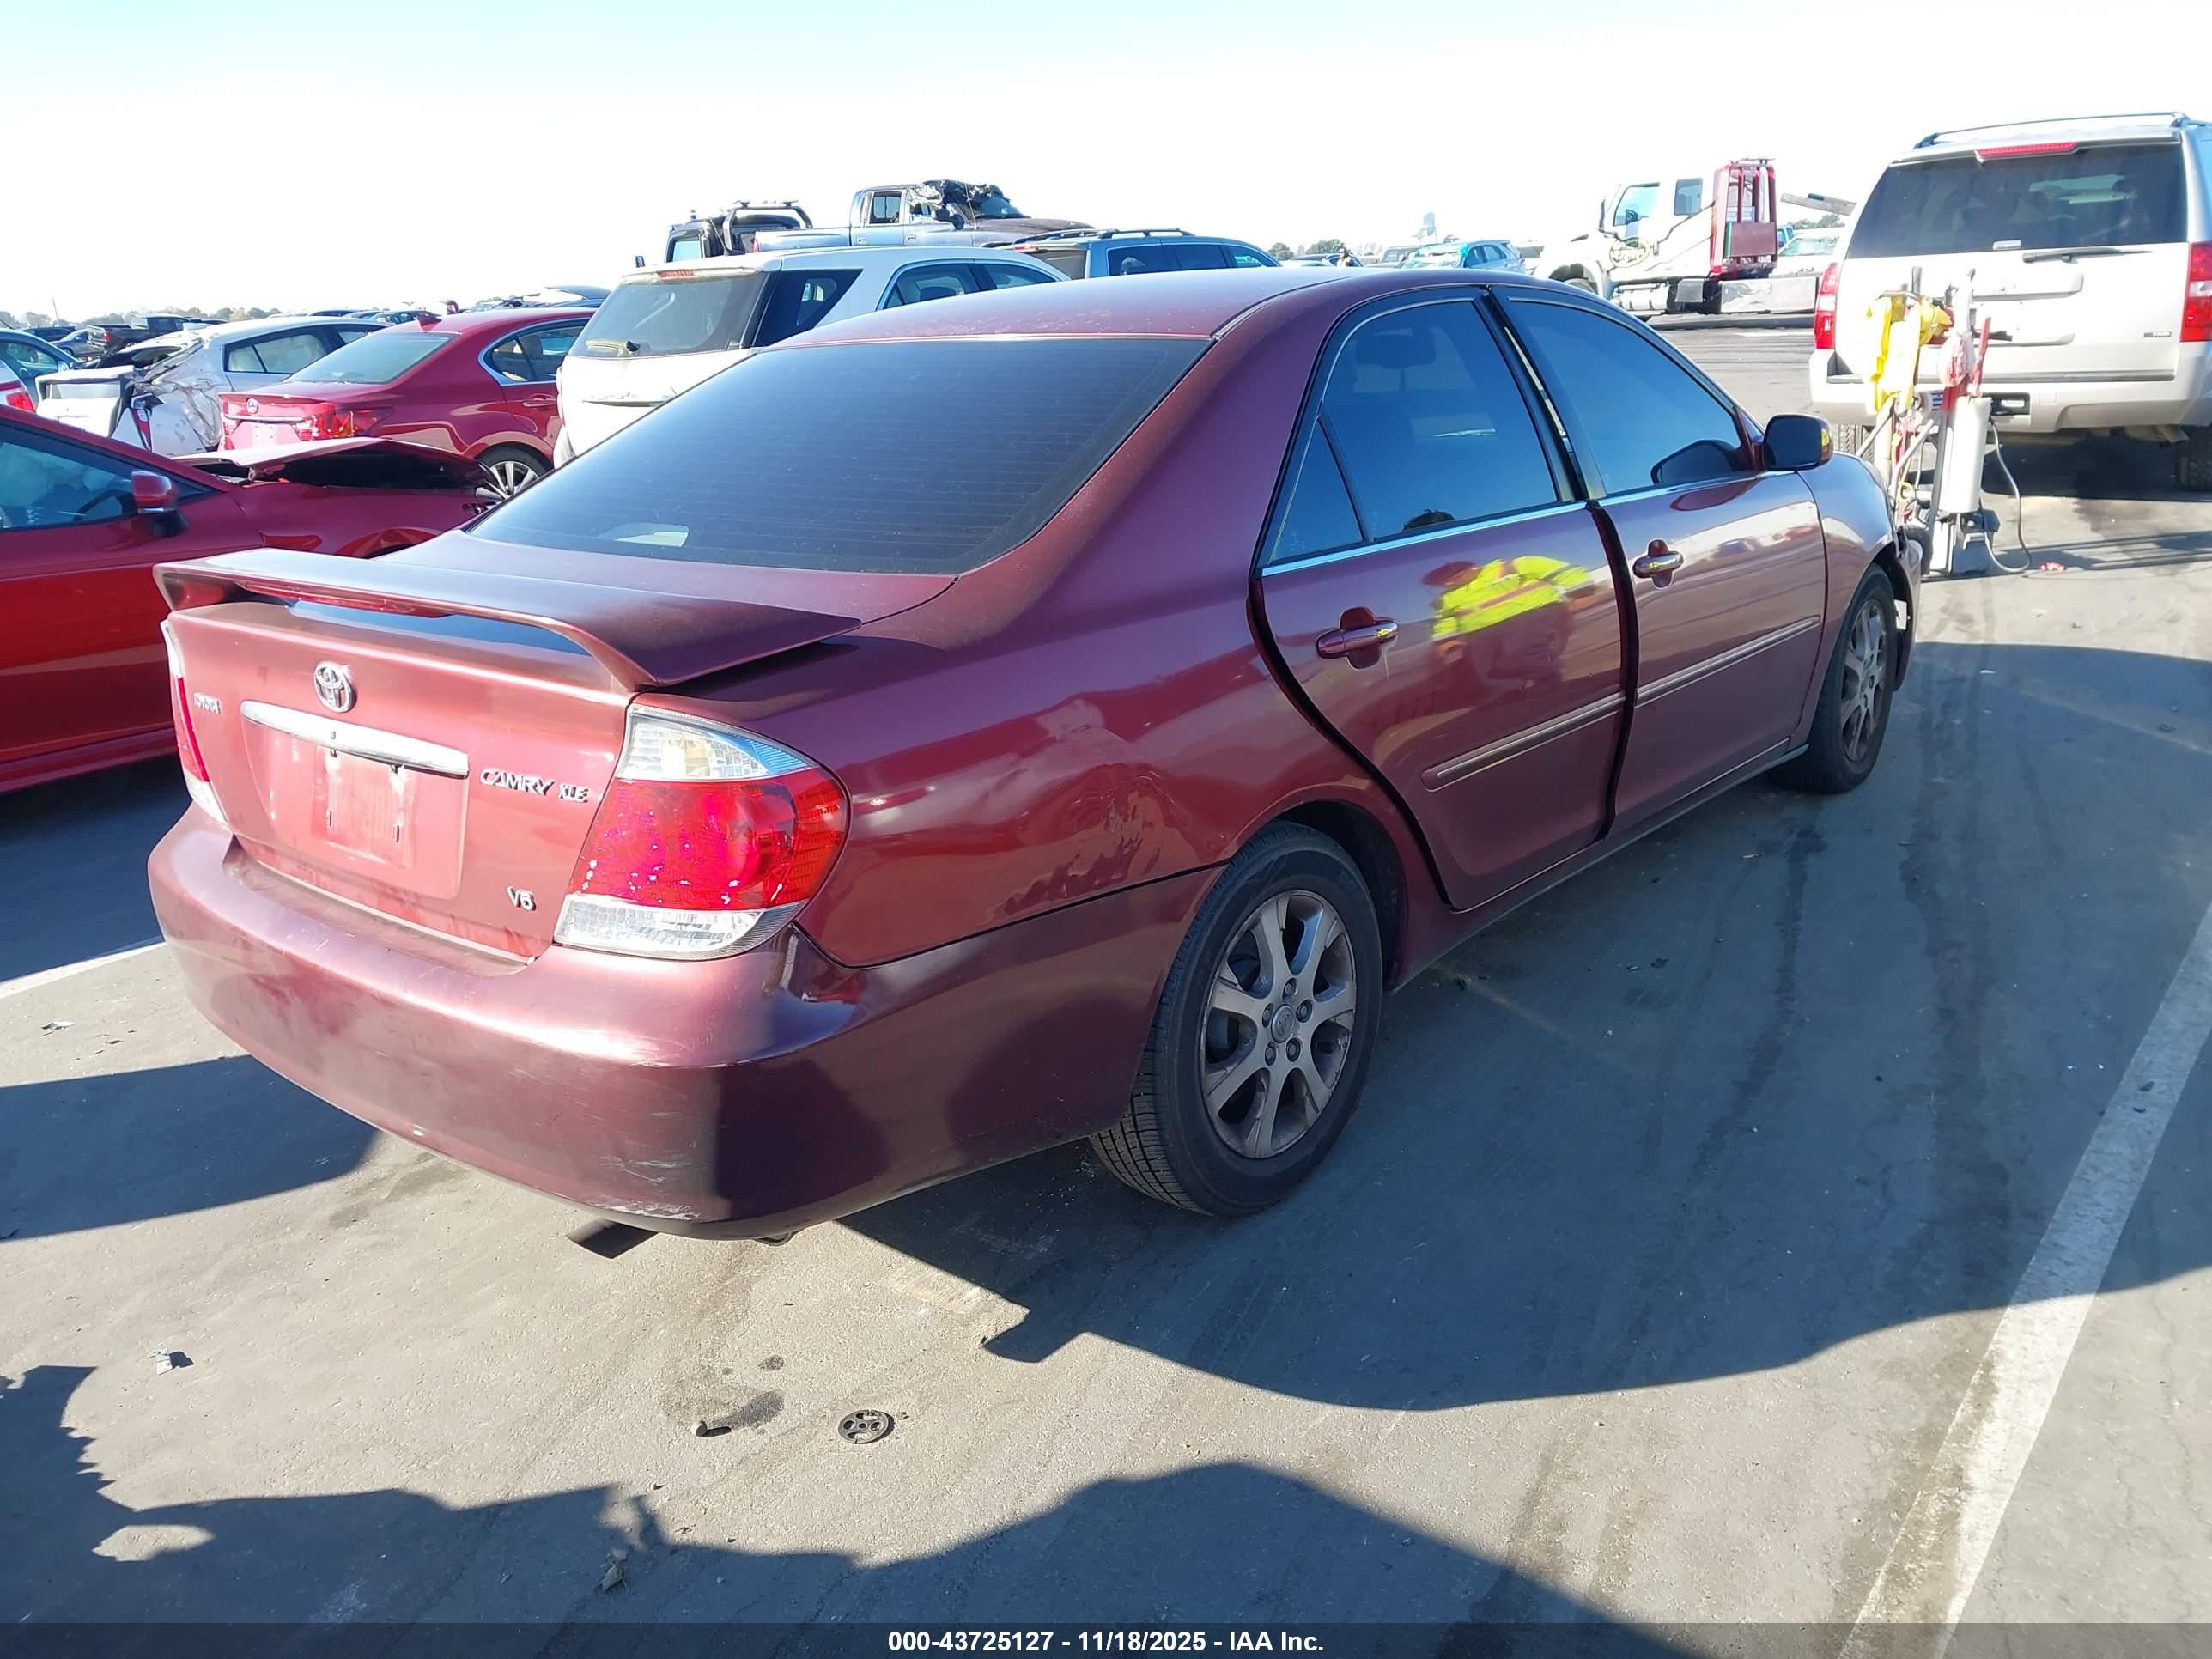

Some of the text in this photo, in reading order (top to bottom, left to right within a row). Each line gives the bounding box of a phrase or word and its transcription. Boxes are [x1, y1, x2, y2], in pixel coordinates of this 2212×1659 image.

[480, 768, 589, 804] CAMRY XLE
[506, 885, 537, 912] V6
